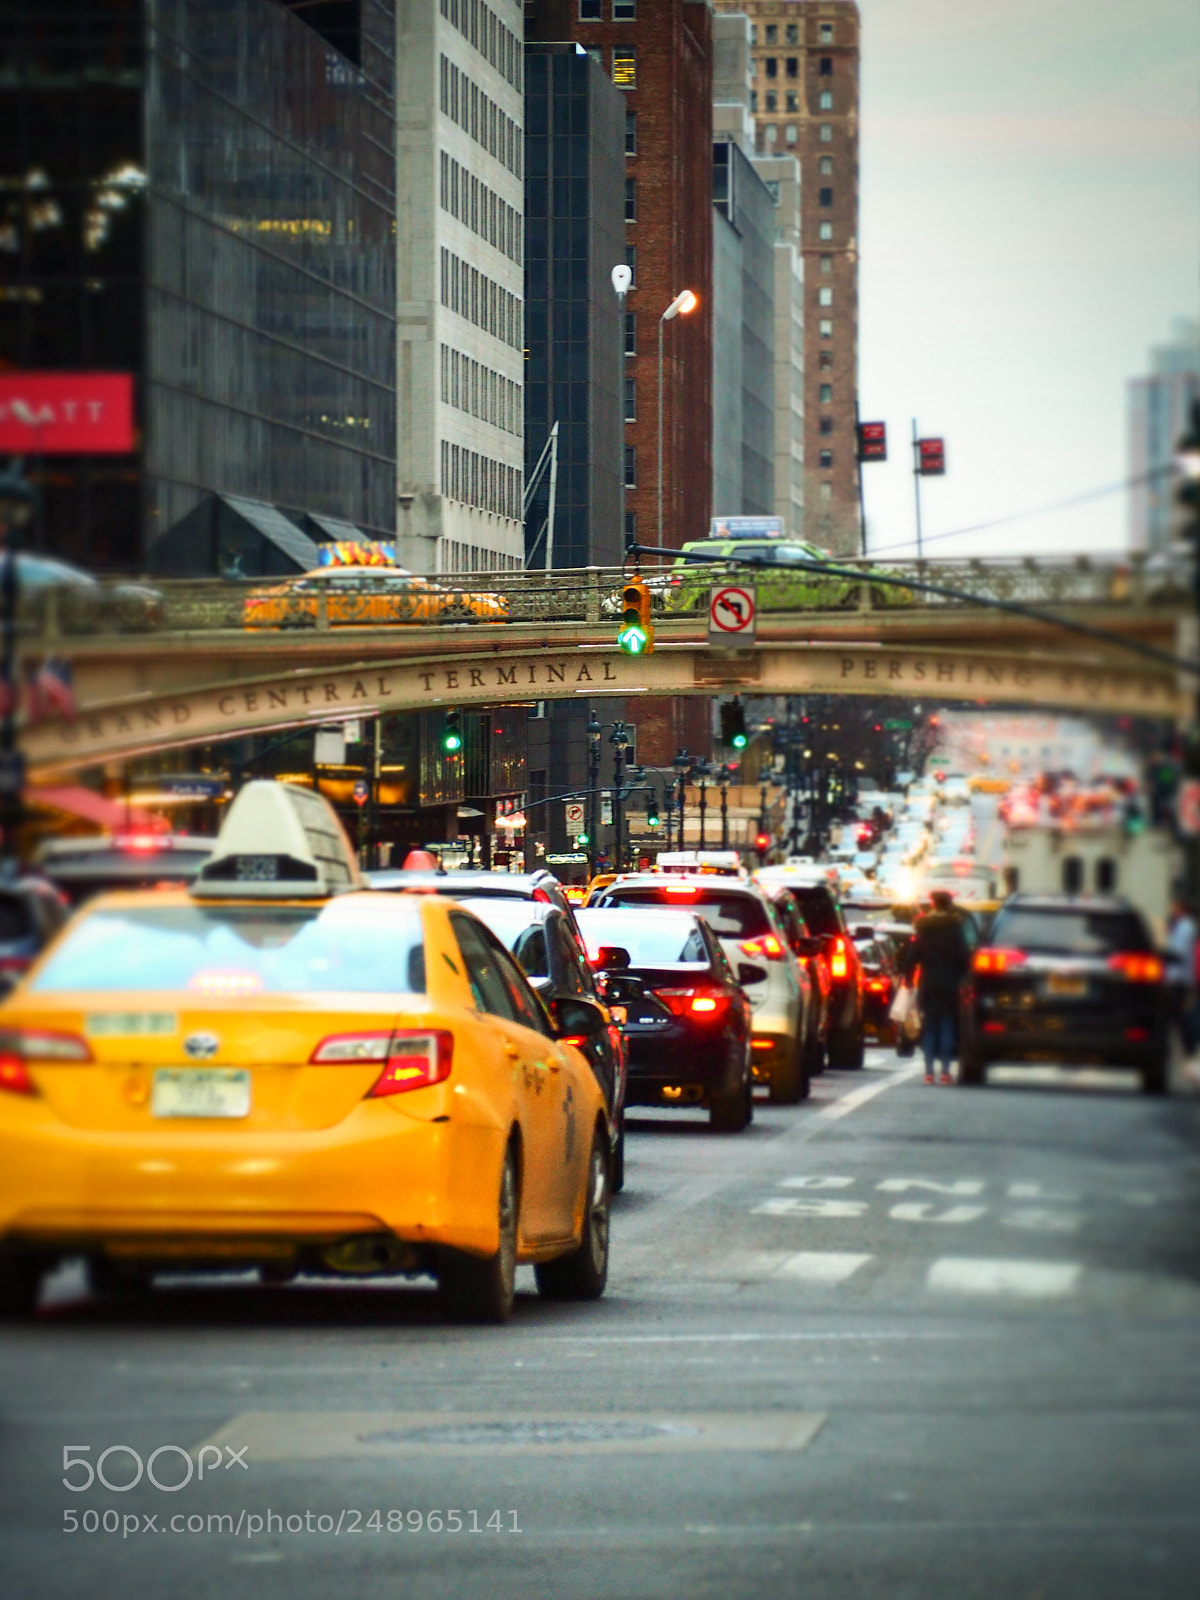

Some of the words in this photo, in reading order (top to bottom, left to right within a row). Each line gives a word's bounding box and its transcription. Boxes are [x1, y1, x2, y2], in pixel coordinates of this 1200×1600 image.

[0, 398, 104, 425] YATT
[840, 658, 1033, 688] PERSHING
[57, 702, 191, 742] GRAND
[218, 676, 393, 716] CENTRAL
[418, 661, 618, 691] TERMINAL
